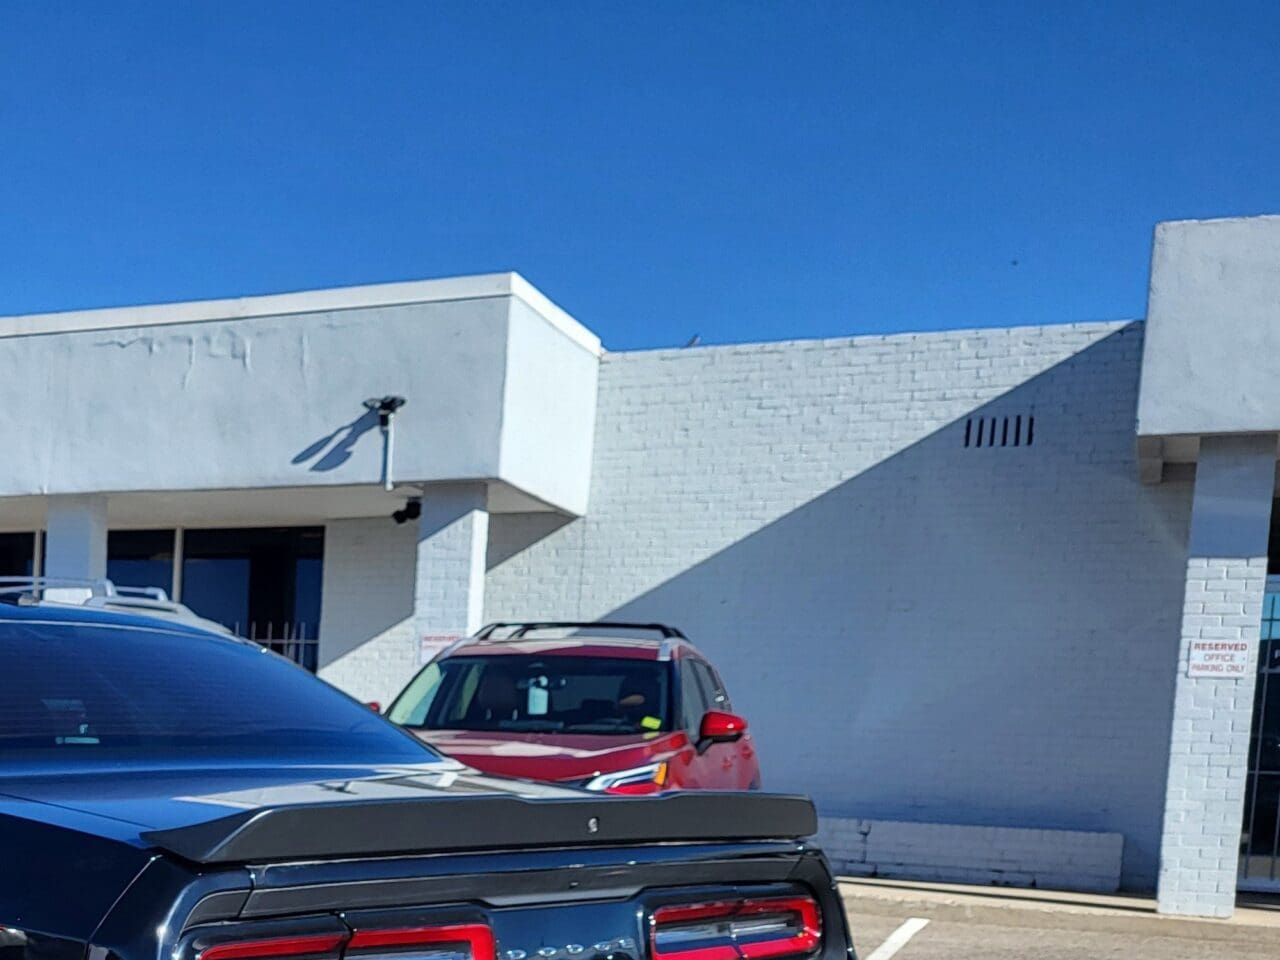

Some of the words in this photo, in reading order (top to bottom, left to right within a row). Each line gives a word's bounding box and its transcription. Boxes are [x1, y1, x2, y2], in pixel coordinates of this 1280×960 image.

[1194, 643, 1248, 651] RESERVED
[1203, 653, 1235, 662] OFFICE
[1226, 664, 1245, 673] ONLY
